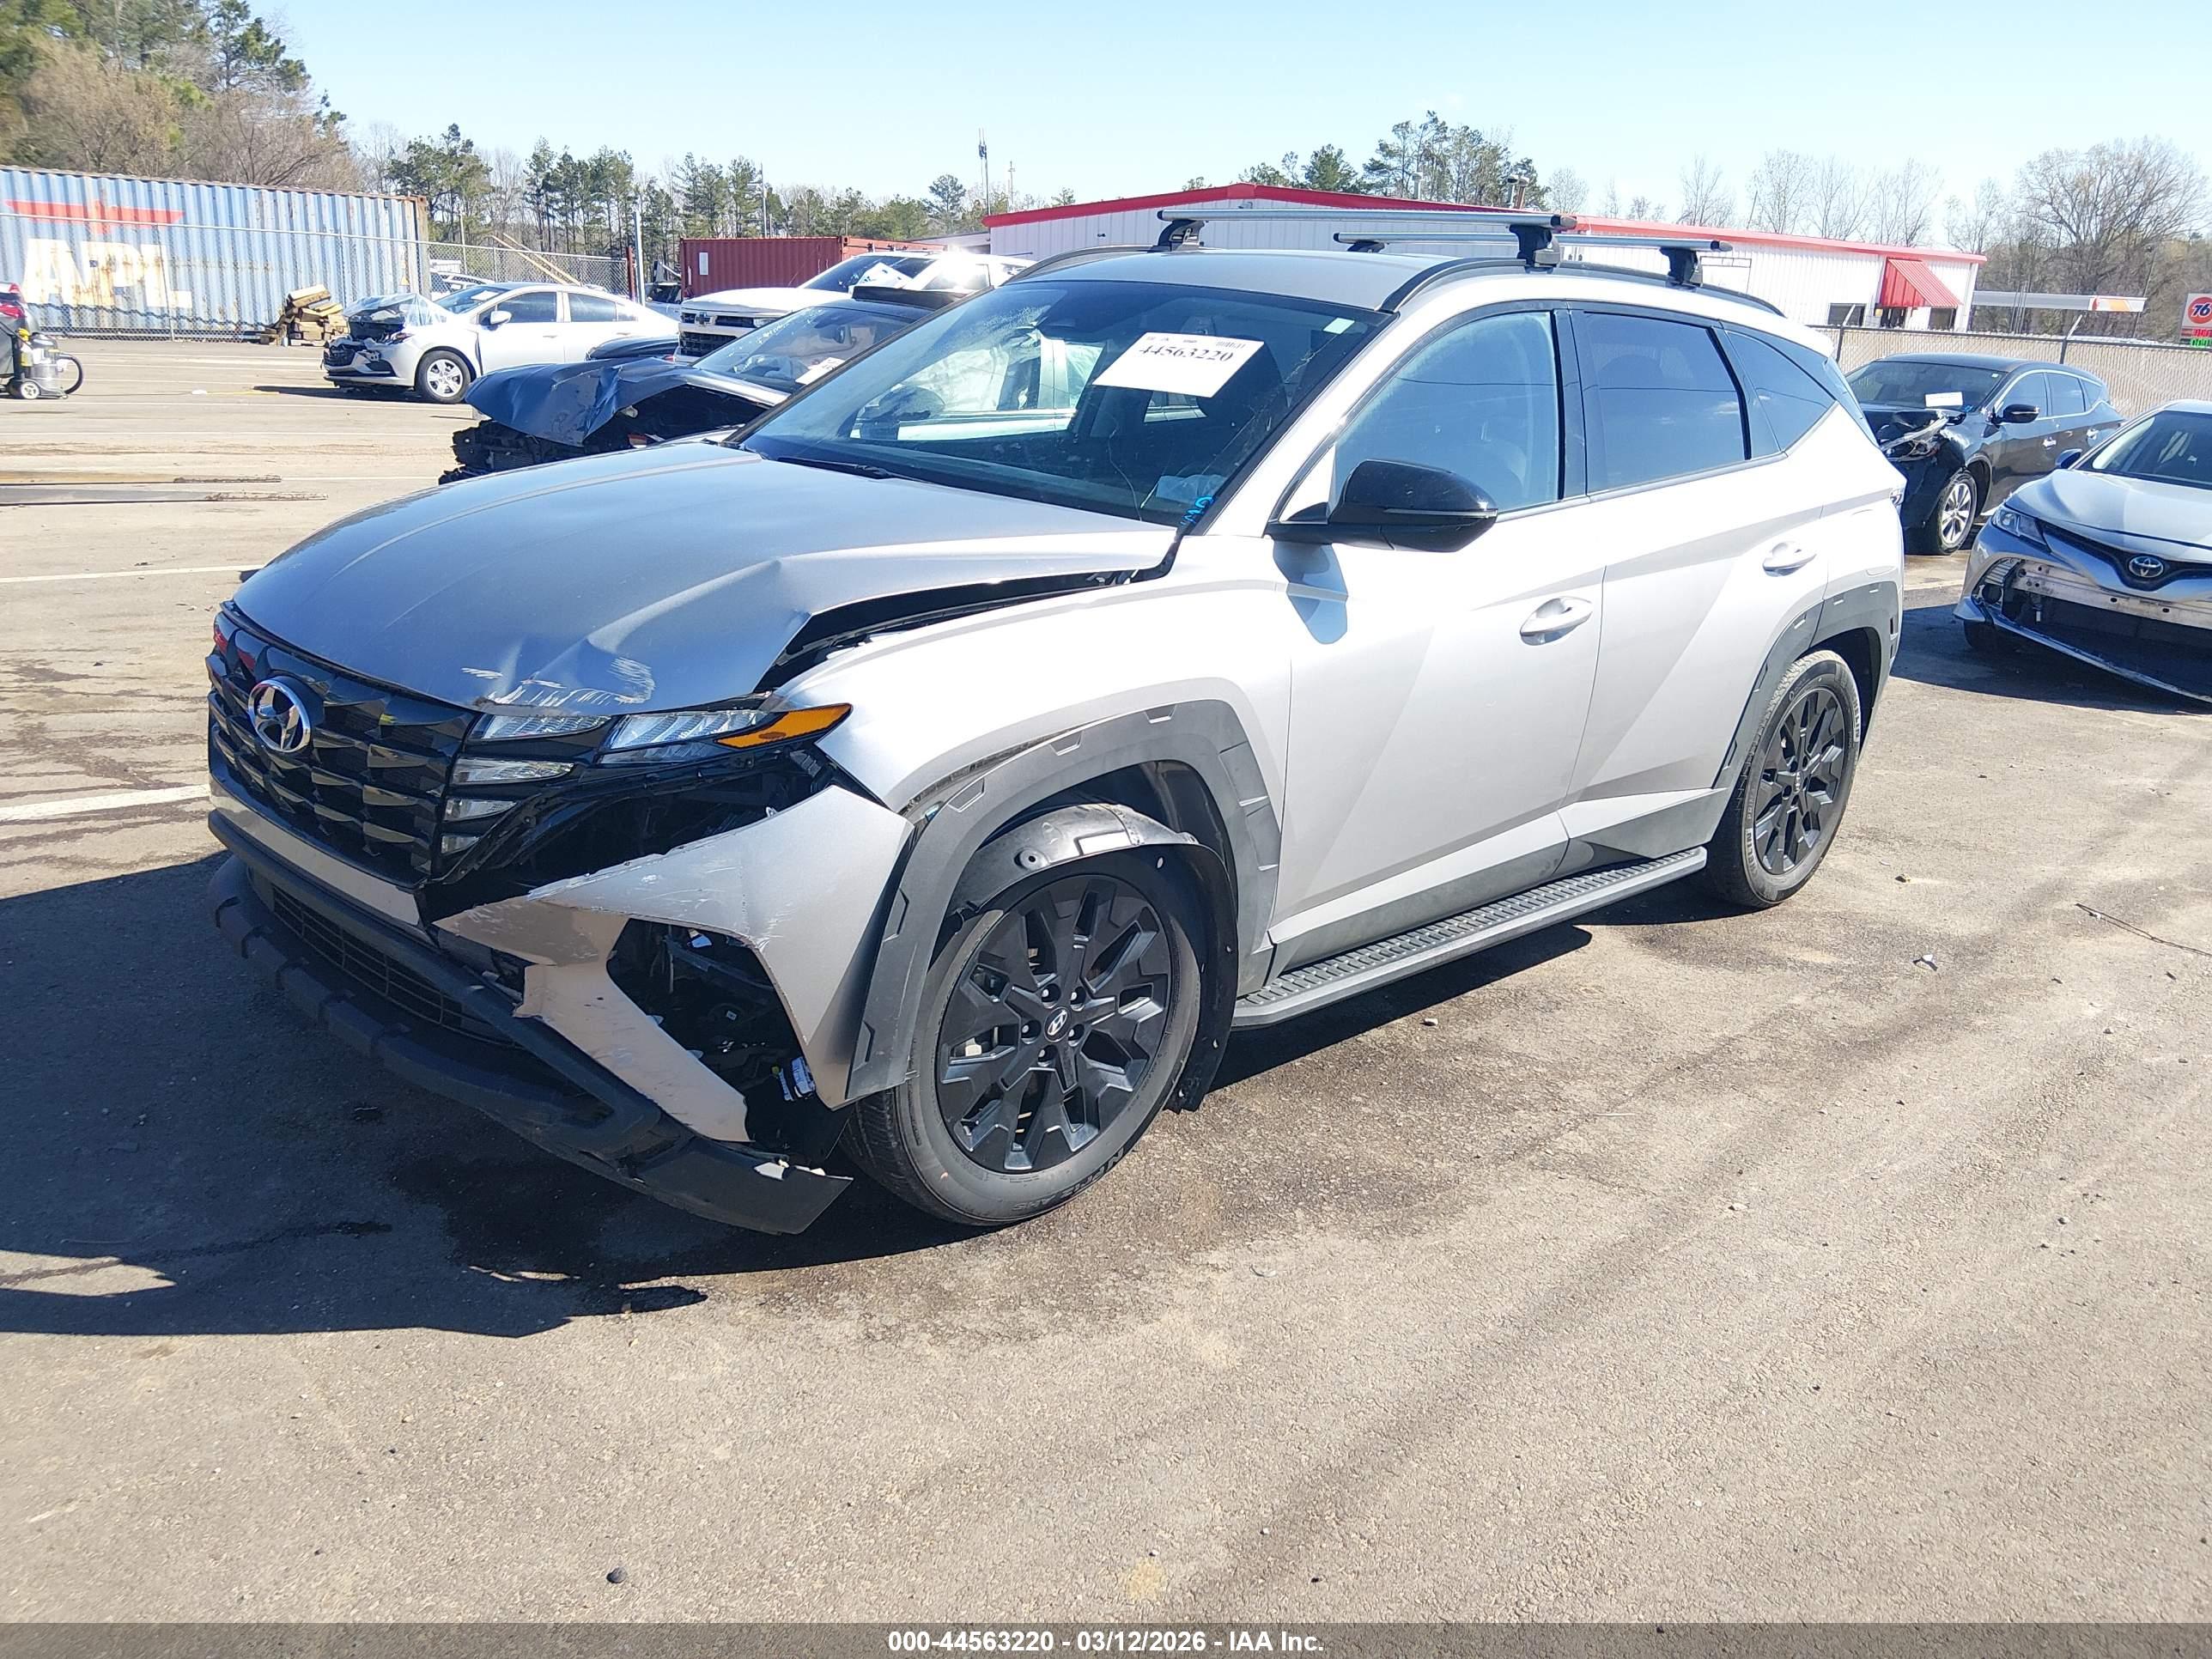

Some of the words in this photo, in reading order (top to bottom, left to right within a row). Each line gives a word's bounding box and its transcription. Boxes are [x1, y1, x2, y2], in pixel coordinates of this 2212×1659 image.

[23, 238, 191, 308] APL
[2192, 302, 2211, 317] 76
[1139, 345, 1234, 362] 44563220
